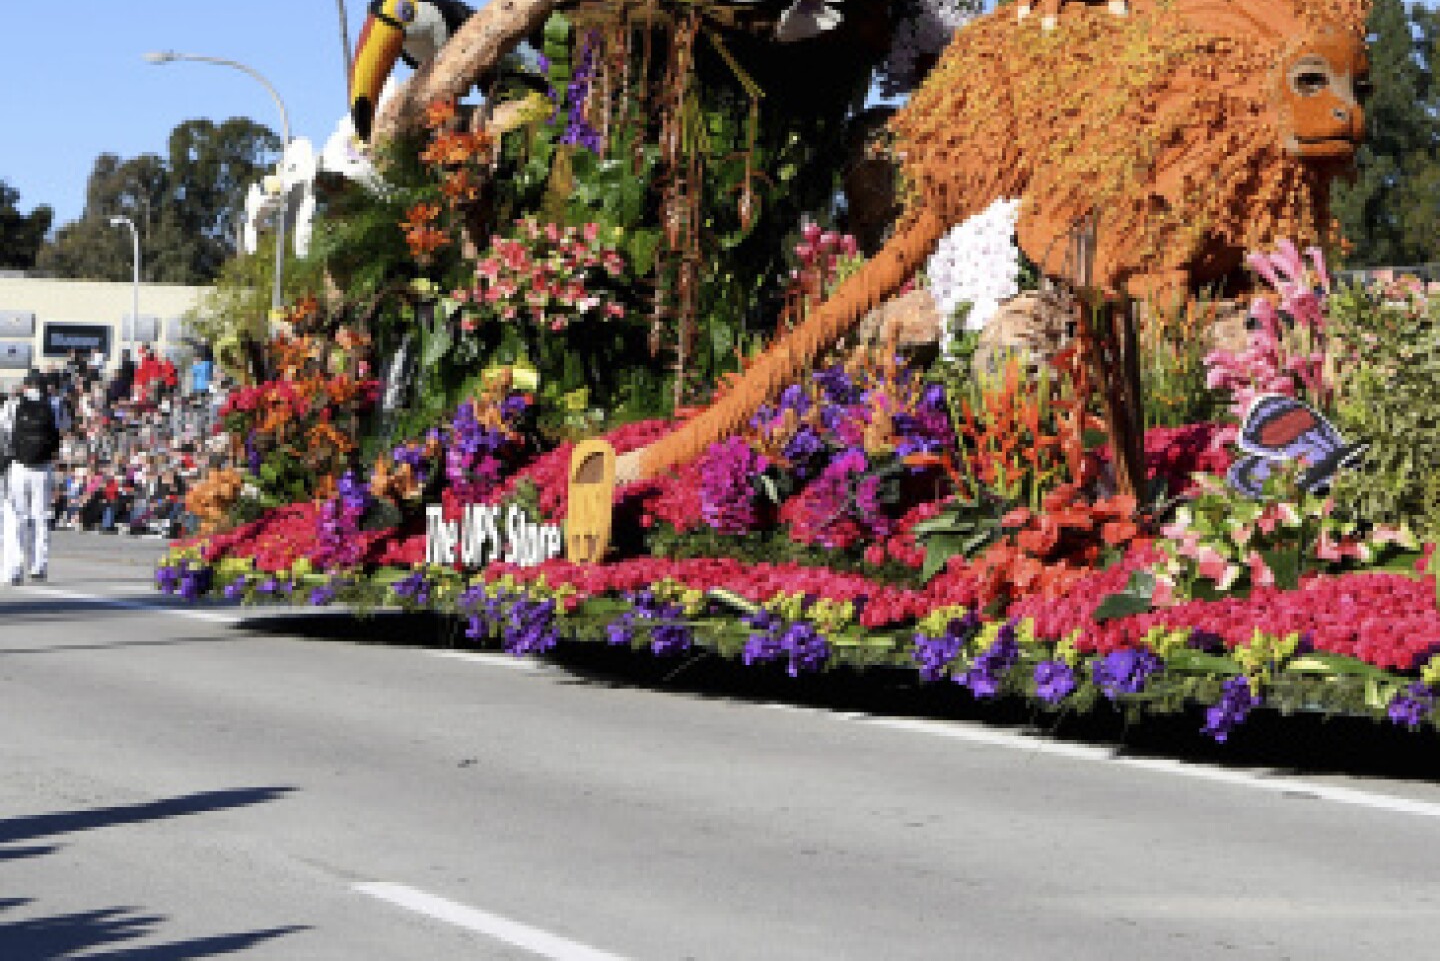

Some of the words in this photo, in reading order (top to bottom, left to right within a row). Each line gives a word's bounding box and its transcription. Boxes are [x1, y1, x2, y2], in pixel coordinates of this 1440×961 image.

[425, 504, 459, 564] The
[461, 503, 501, 566] UPS
[504, 503, 561, 566] Store
